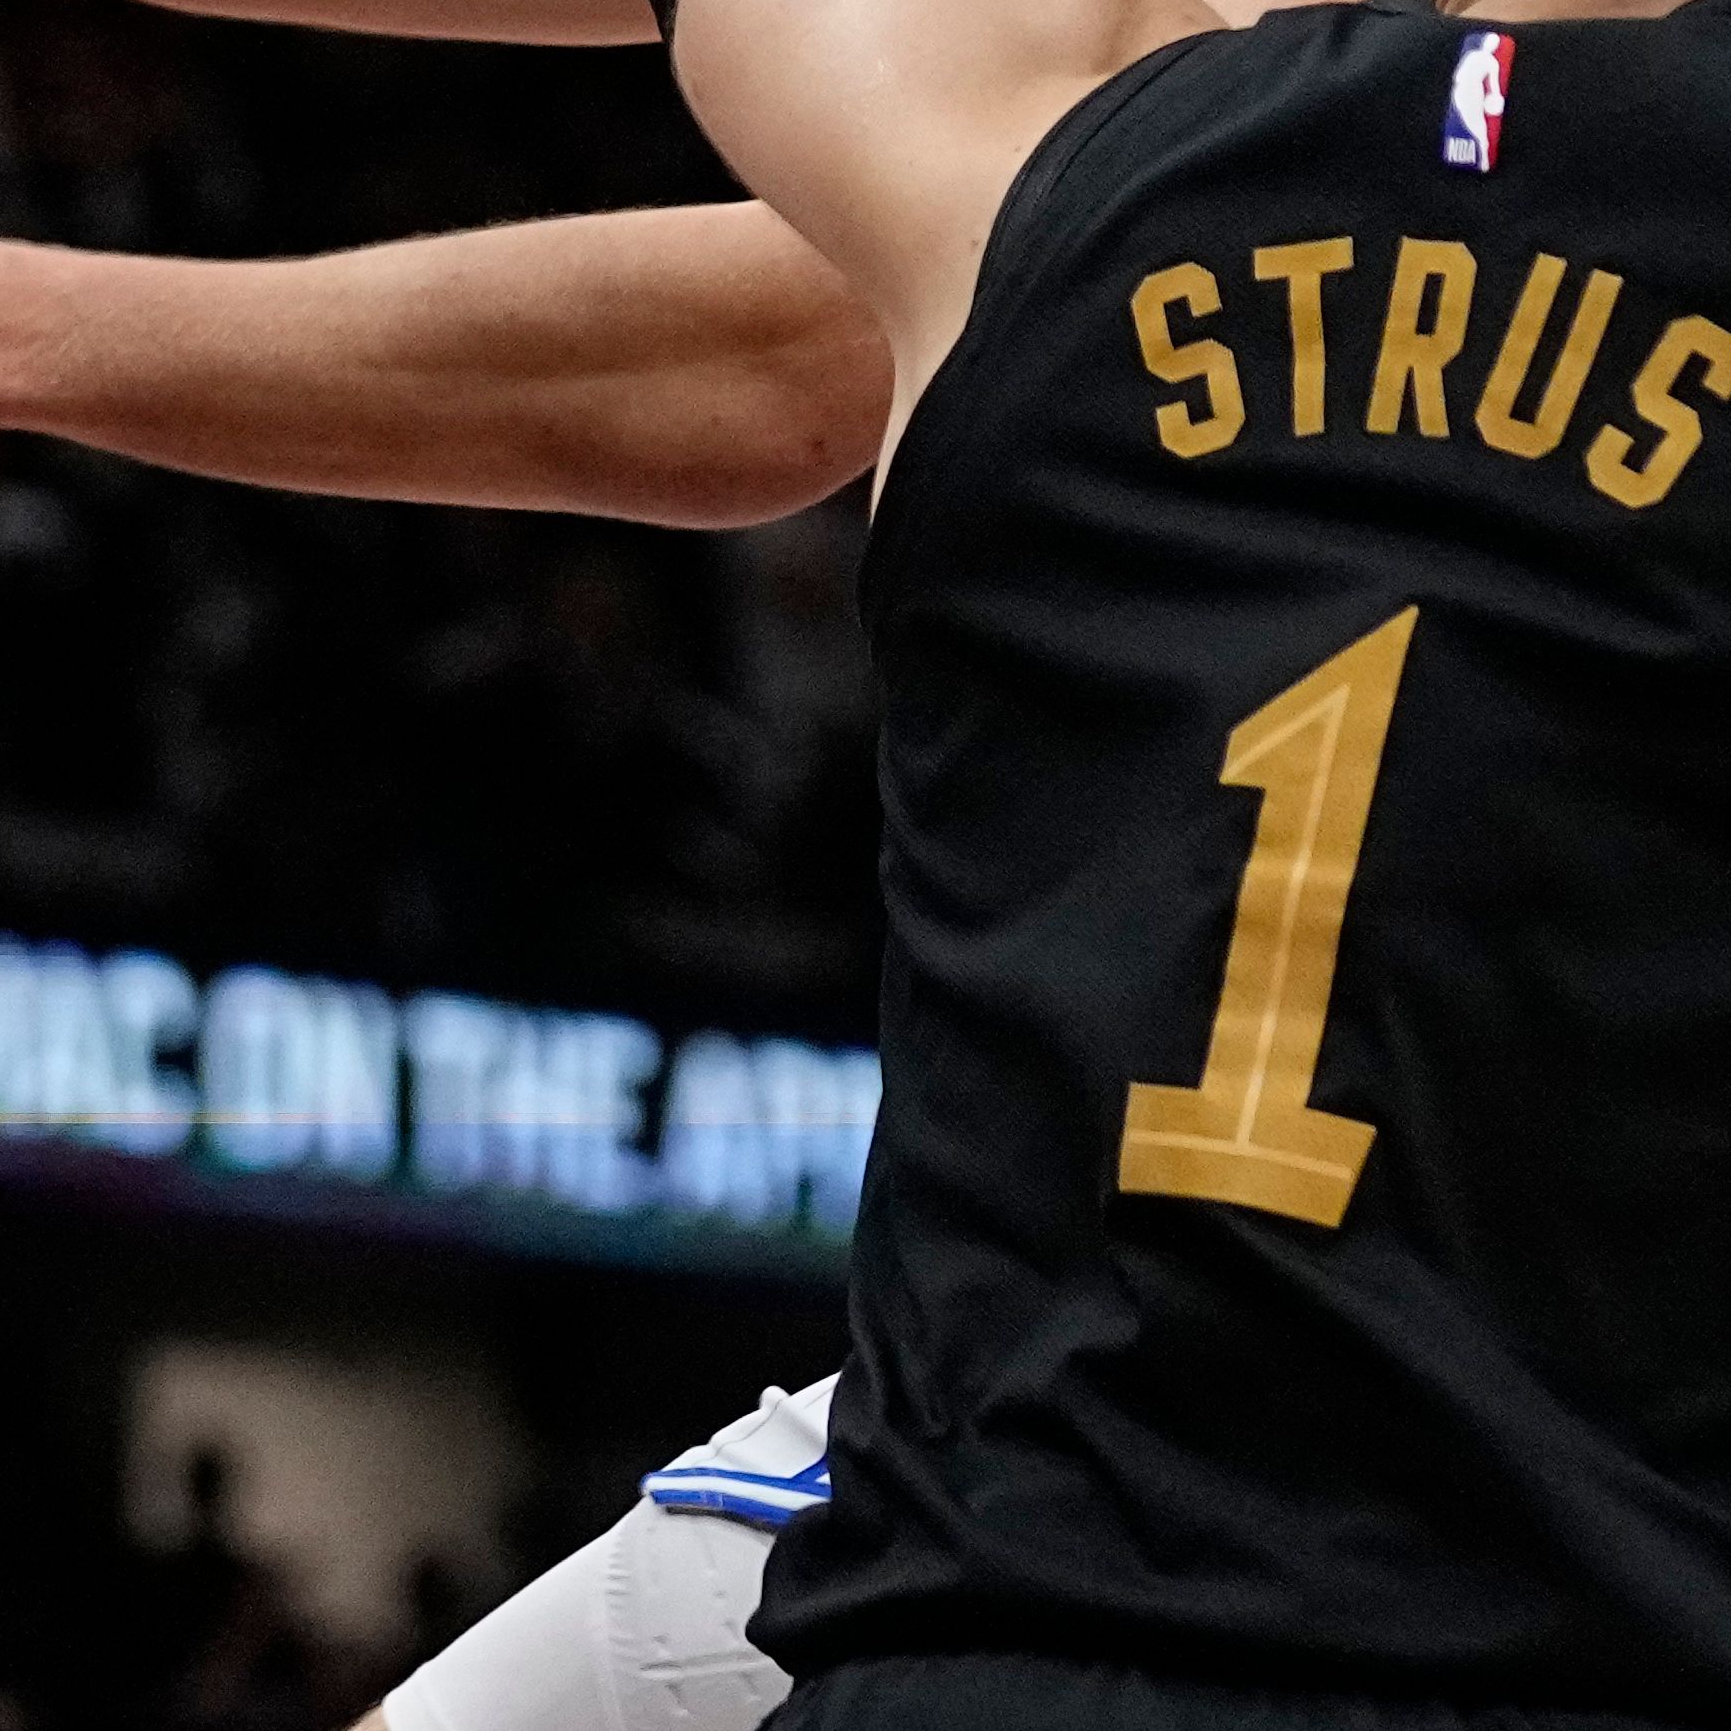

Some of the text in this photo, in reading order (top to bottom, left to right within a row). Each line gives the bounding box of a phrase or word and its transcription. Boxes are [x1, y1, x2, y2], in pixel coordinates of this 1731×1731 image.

[196, 962, 396, 1170] ON
[400, 988, 666, 1212] THE
[1118, 604, 1420, 1229] 1
